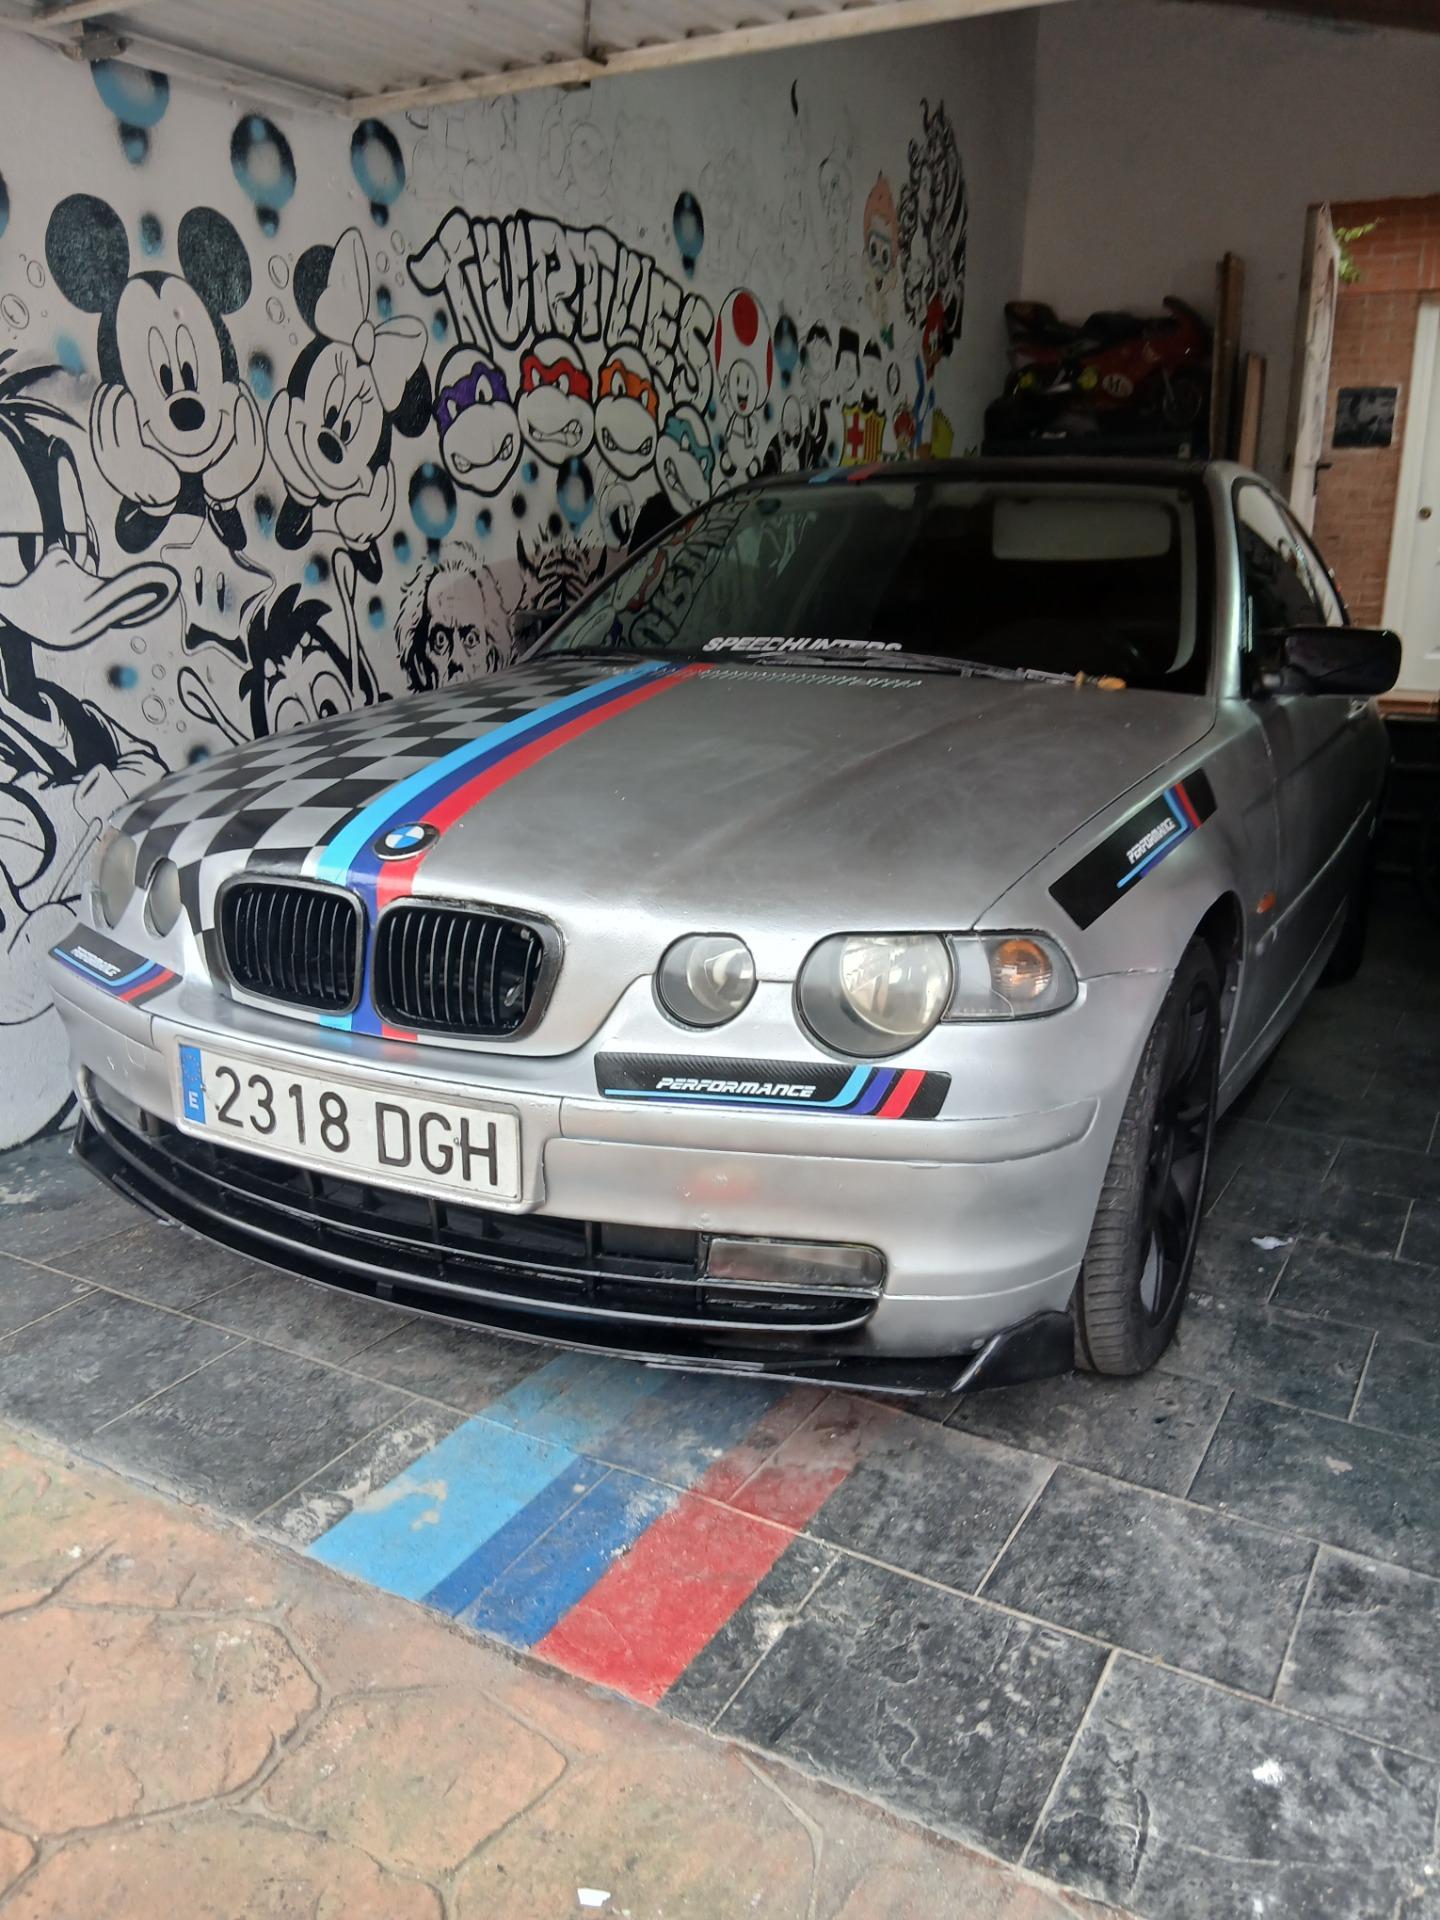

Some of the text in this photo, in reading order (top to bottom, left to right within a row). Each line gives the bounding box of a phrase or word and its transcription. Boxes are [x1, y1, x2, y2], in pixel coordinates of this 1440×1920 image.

[656, 1077, 816, 1098] PERFORMANCE
[188, 1091, 199, 1109] E
[215, 1066, 498, 1186] 2318 DGH
